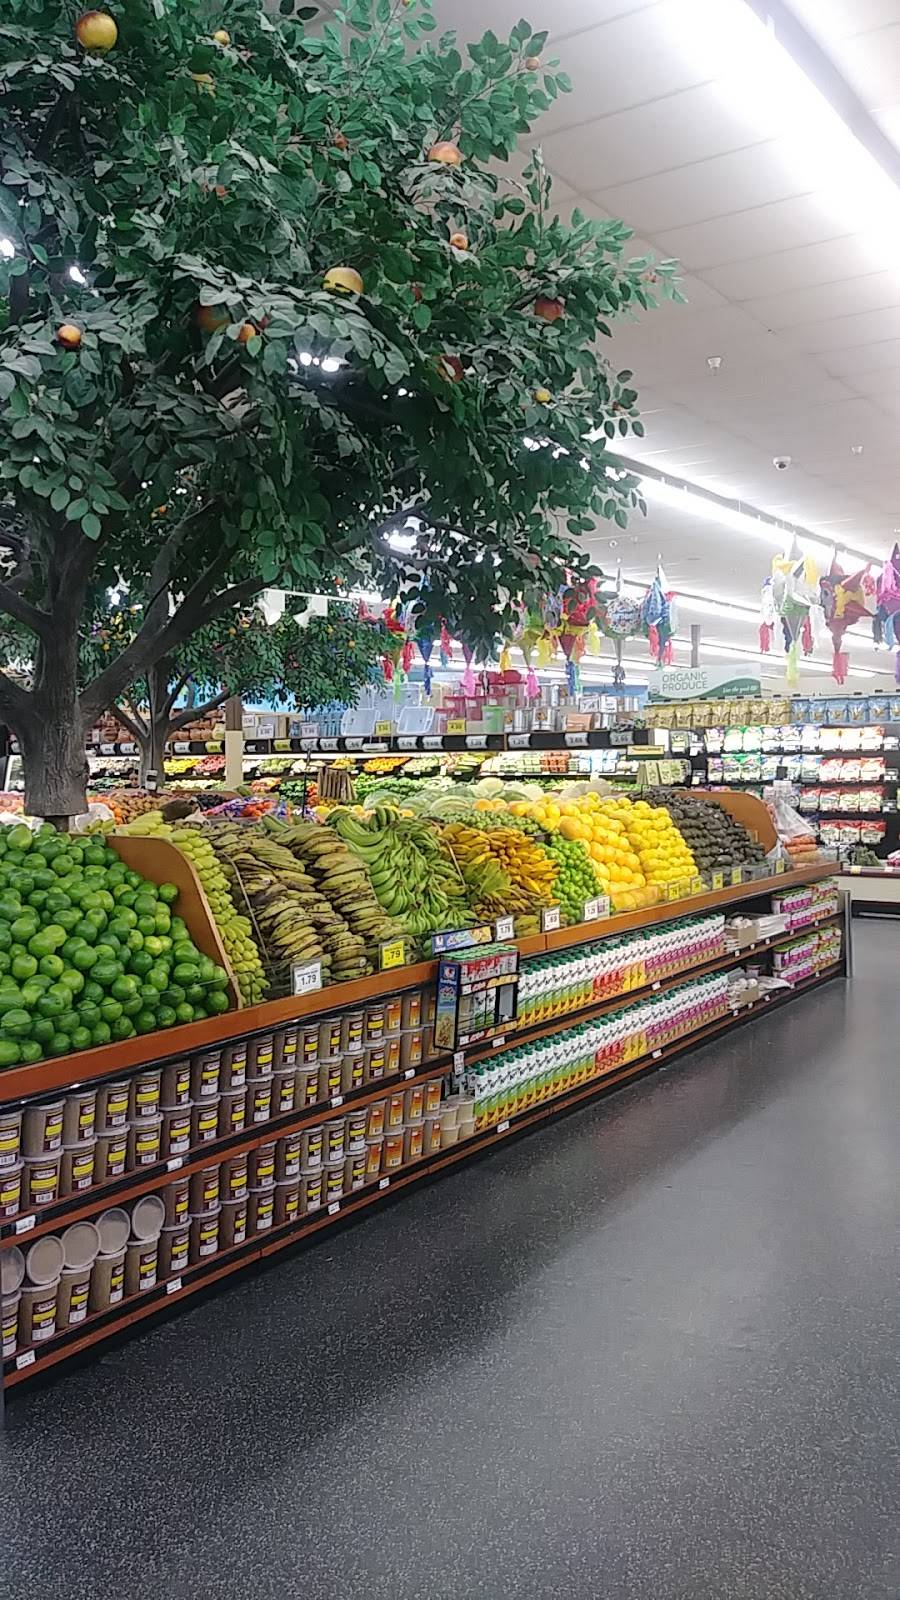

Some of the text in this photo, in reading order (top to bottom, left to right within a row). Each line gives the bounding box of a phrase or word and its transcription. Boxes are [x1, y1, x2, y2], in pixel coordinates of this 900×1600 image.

[662, 671, 708, 683] ORGANIC
[662, 681, 708, 692] PRODUCE
[387, 950, 401, 960] .79
[301, 974, 316, 985] 1.79
